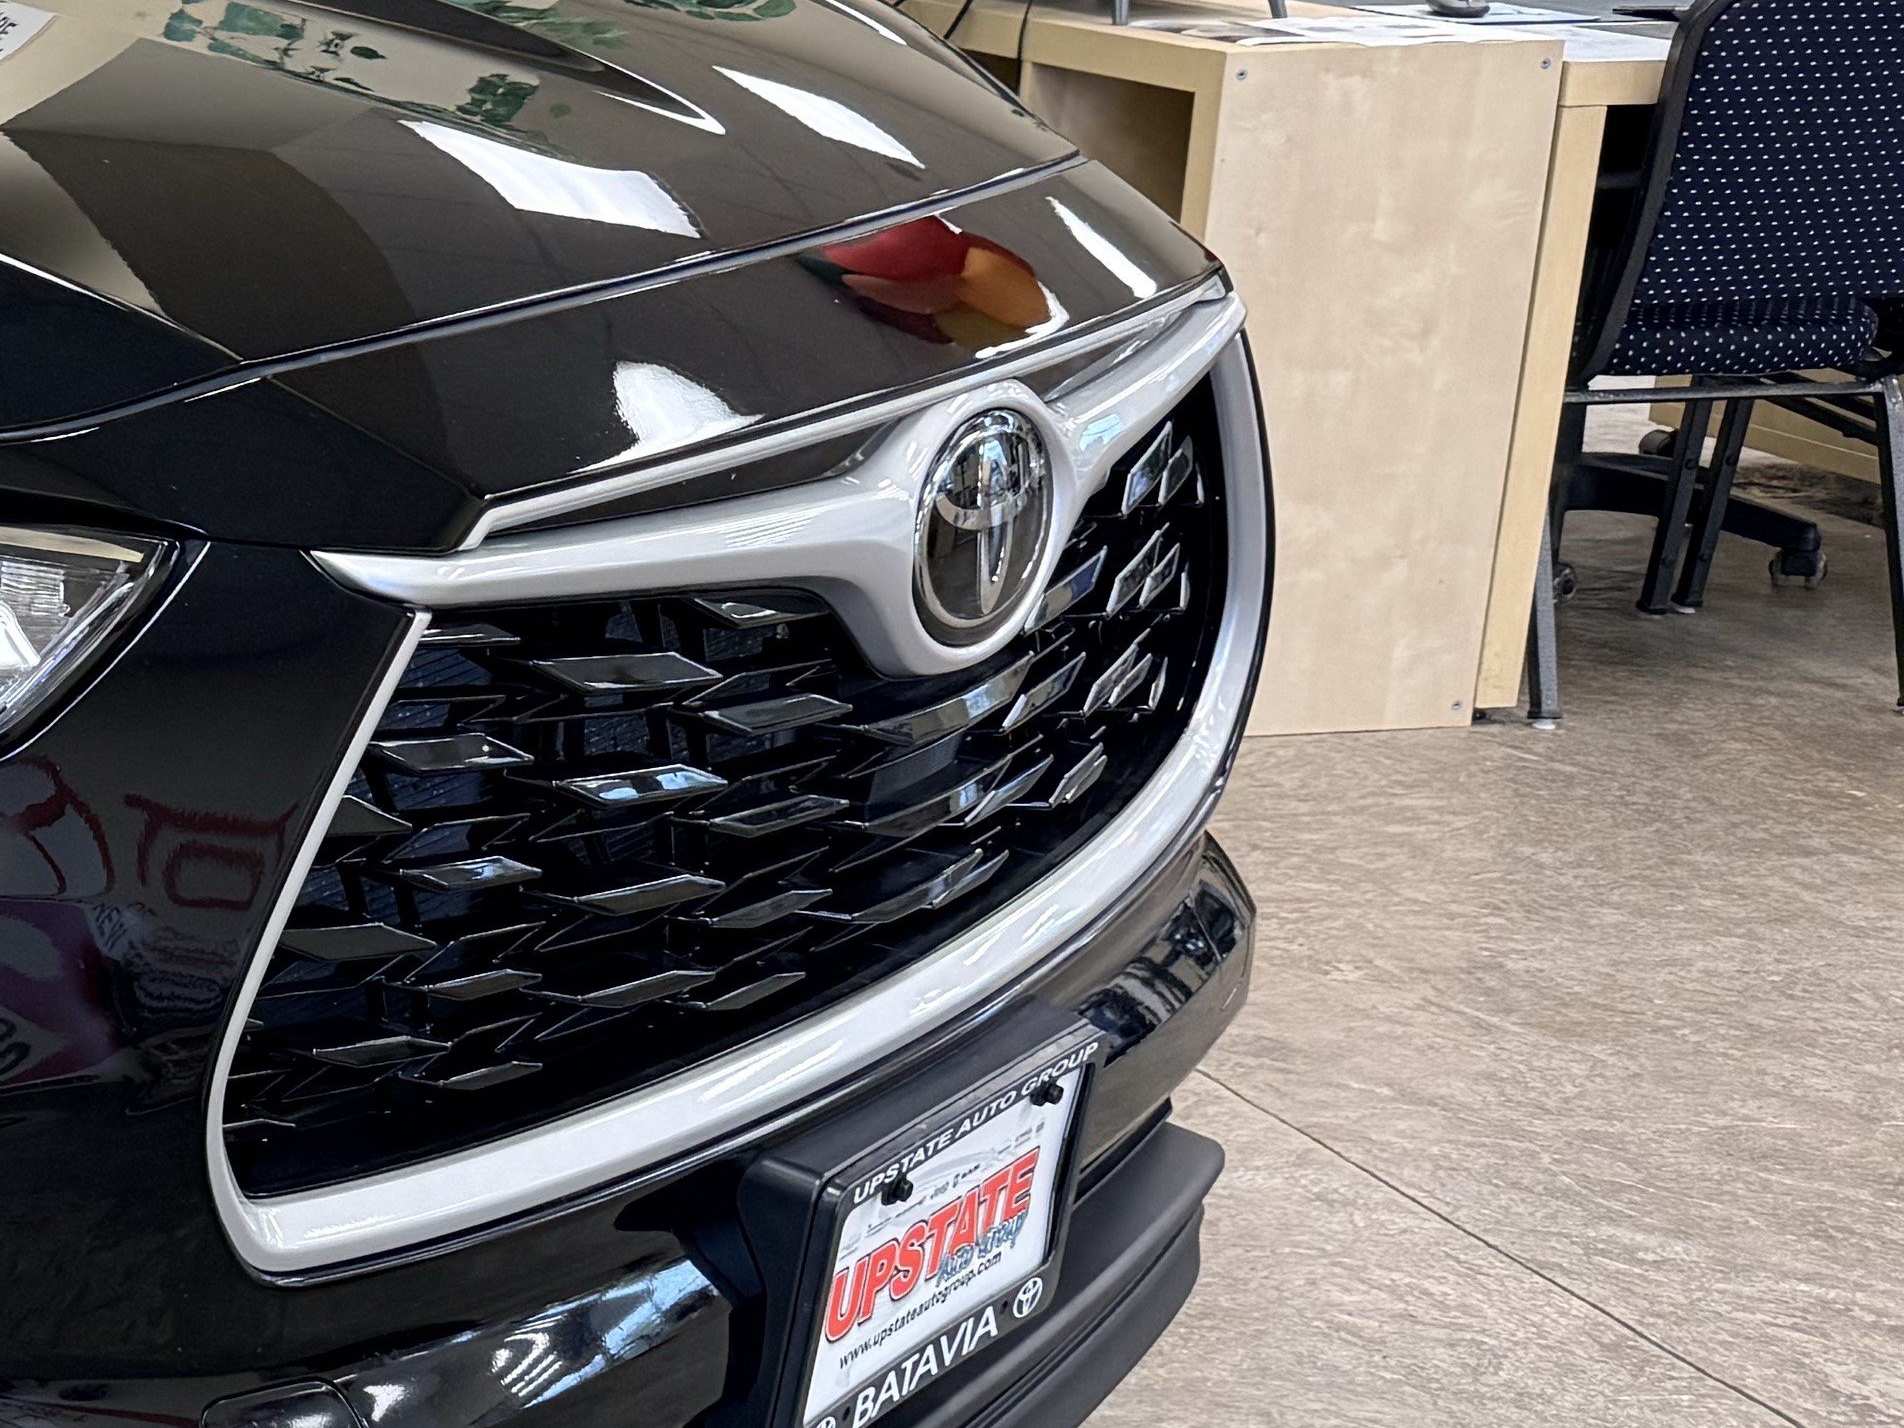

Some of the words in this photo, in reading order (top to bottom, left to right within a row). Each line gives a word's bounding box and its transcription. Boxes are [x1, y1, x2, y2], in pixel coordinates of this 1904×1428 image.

[853, 1132, 953, 1204] UPSTATE
[955, 1091, 1017, 1139] AUTO
[1021, 1042, 1099, 1097] GROUP
[825, 1146, 1041, 1343] UPSTATE
[839, 1252, 1002, 1370] www.upstateautogroup.com
